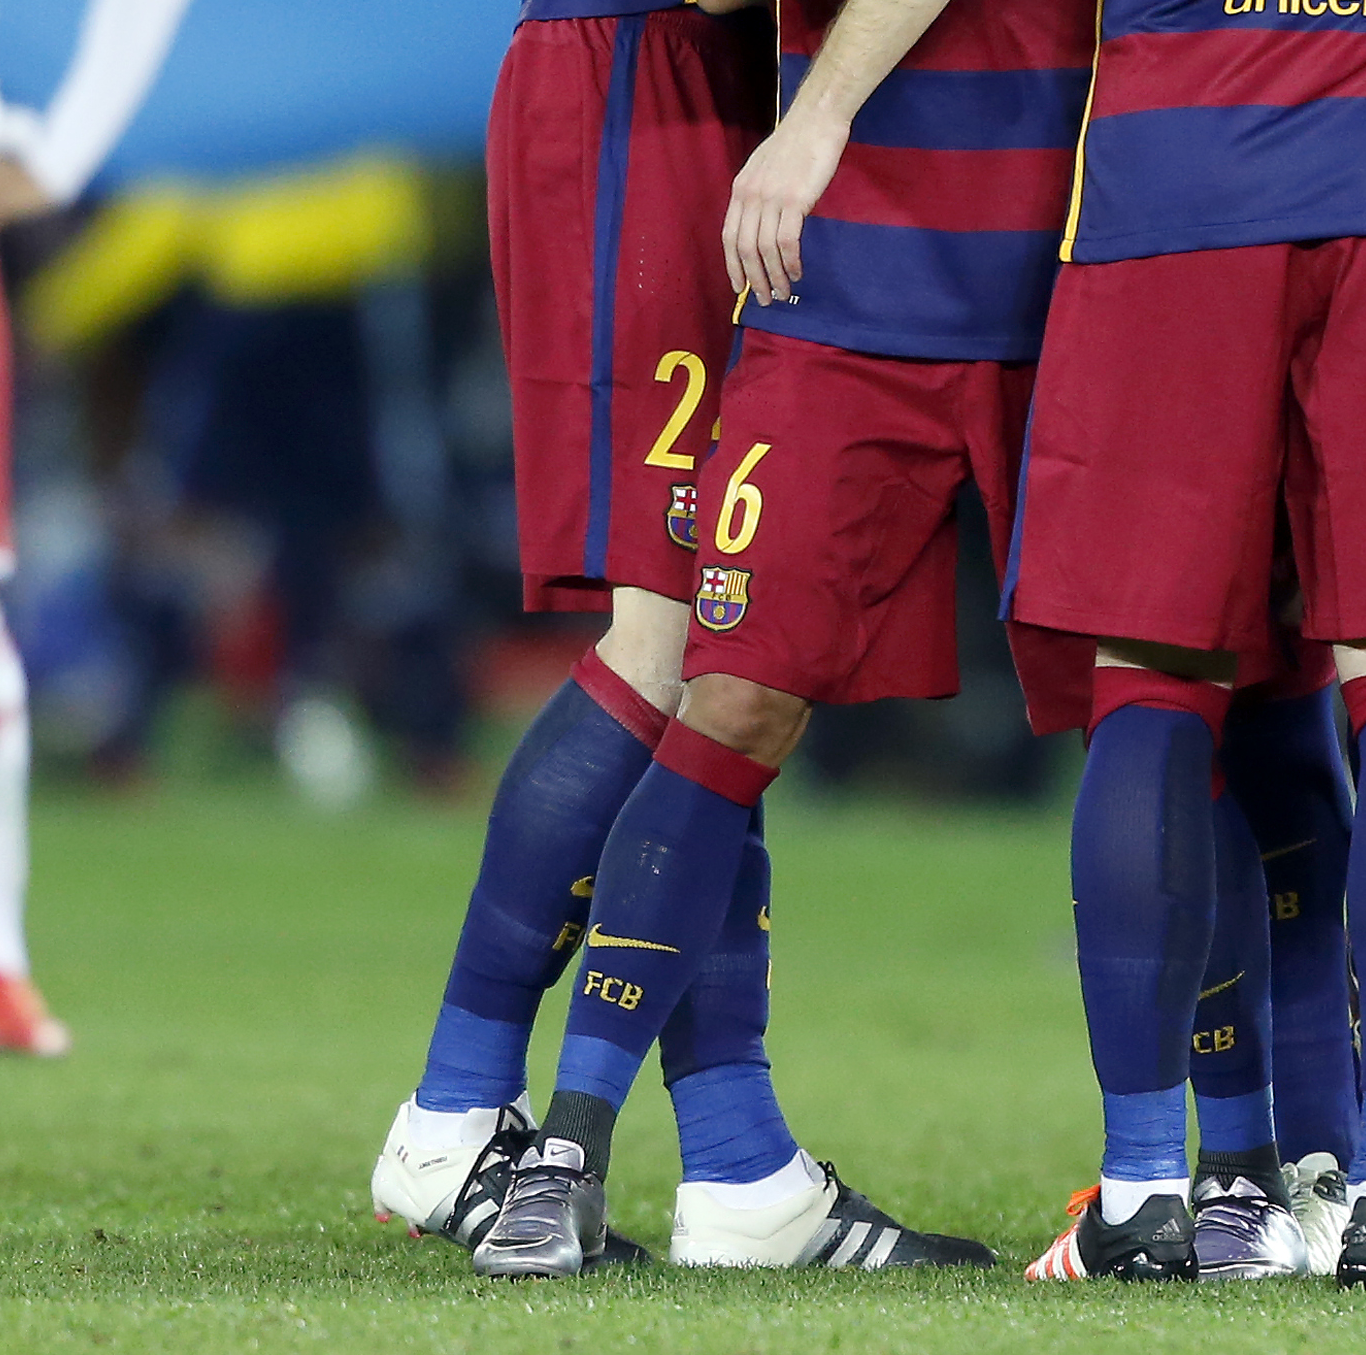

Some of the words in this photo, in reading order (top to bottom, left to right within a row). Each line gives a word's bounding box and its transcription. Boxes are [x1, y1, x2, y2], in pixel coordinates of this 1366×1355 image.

[644, 350, 721, 471] 2
[714, 443, 772, 554] 6
[583, 970, 644, 1011] FCB
[1192, 1025, 1235, 1054] CB
